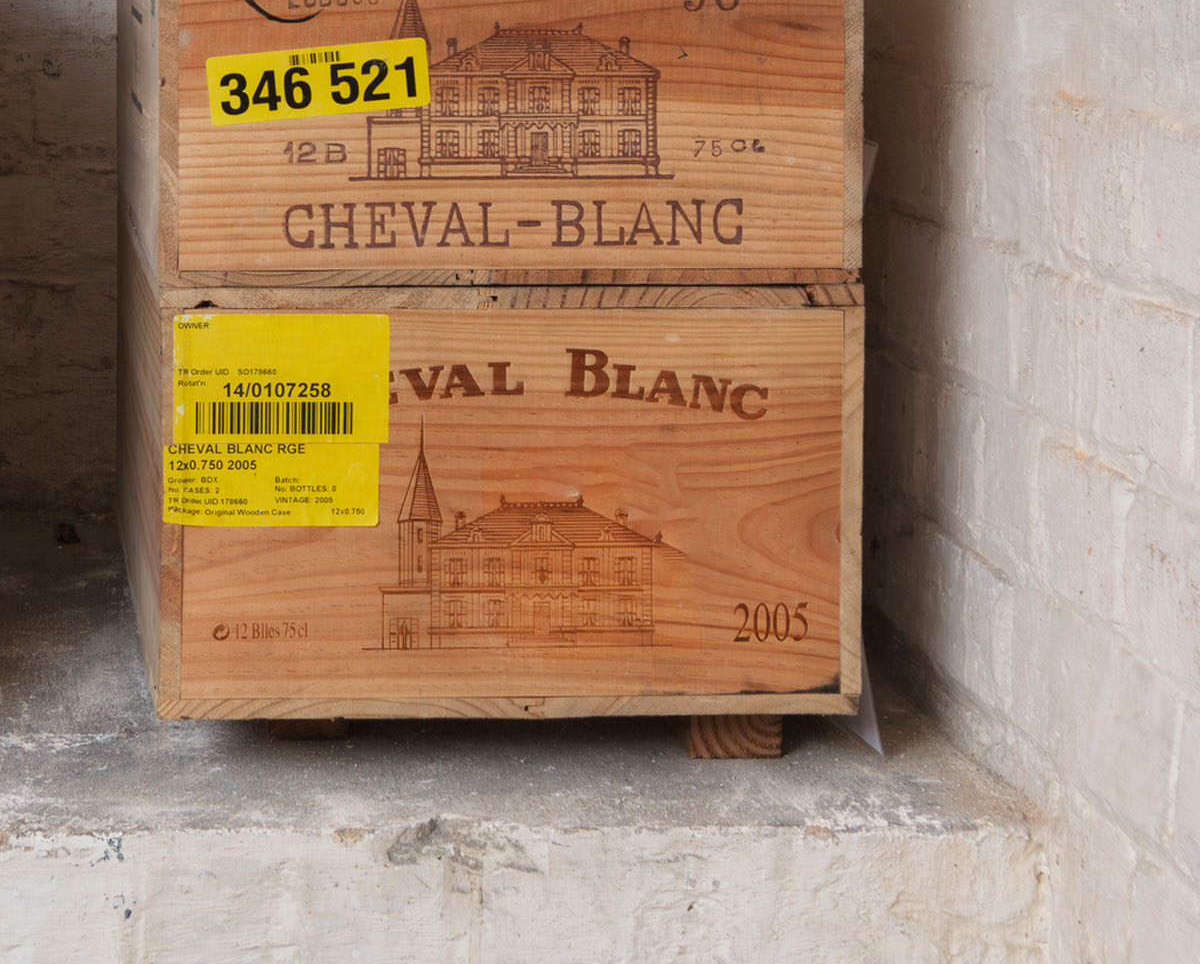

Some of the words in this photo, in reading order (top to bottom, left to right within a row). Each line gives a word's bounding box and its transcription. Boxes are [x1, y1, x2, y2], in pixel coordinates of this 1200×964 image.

[190, 368, 212, 376] Order
[215, 368, 229, 376] UID
[389, 362, 525, 404] VAL
[223, 382, 331, 398] 14/0107258
[168, 443, 222, 455] CHEVAL
[227, 443, 273, 454] BLANC
[277, 443, 305, 454] RGE
[169, 459, 223, 471] 12x0.750
[227, 459, 257, 470] 2005
[315, 496, 333, 504] 2005
[205, 508, 235, 517] Original
[237, 508, 269, 516] Wooden
[271, 508, 291, 516] Case
[733, 600, 810, 643] 2005
[236, 622, 248, 640] 12
[282, 621, 296, 638] 75
